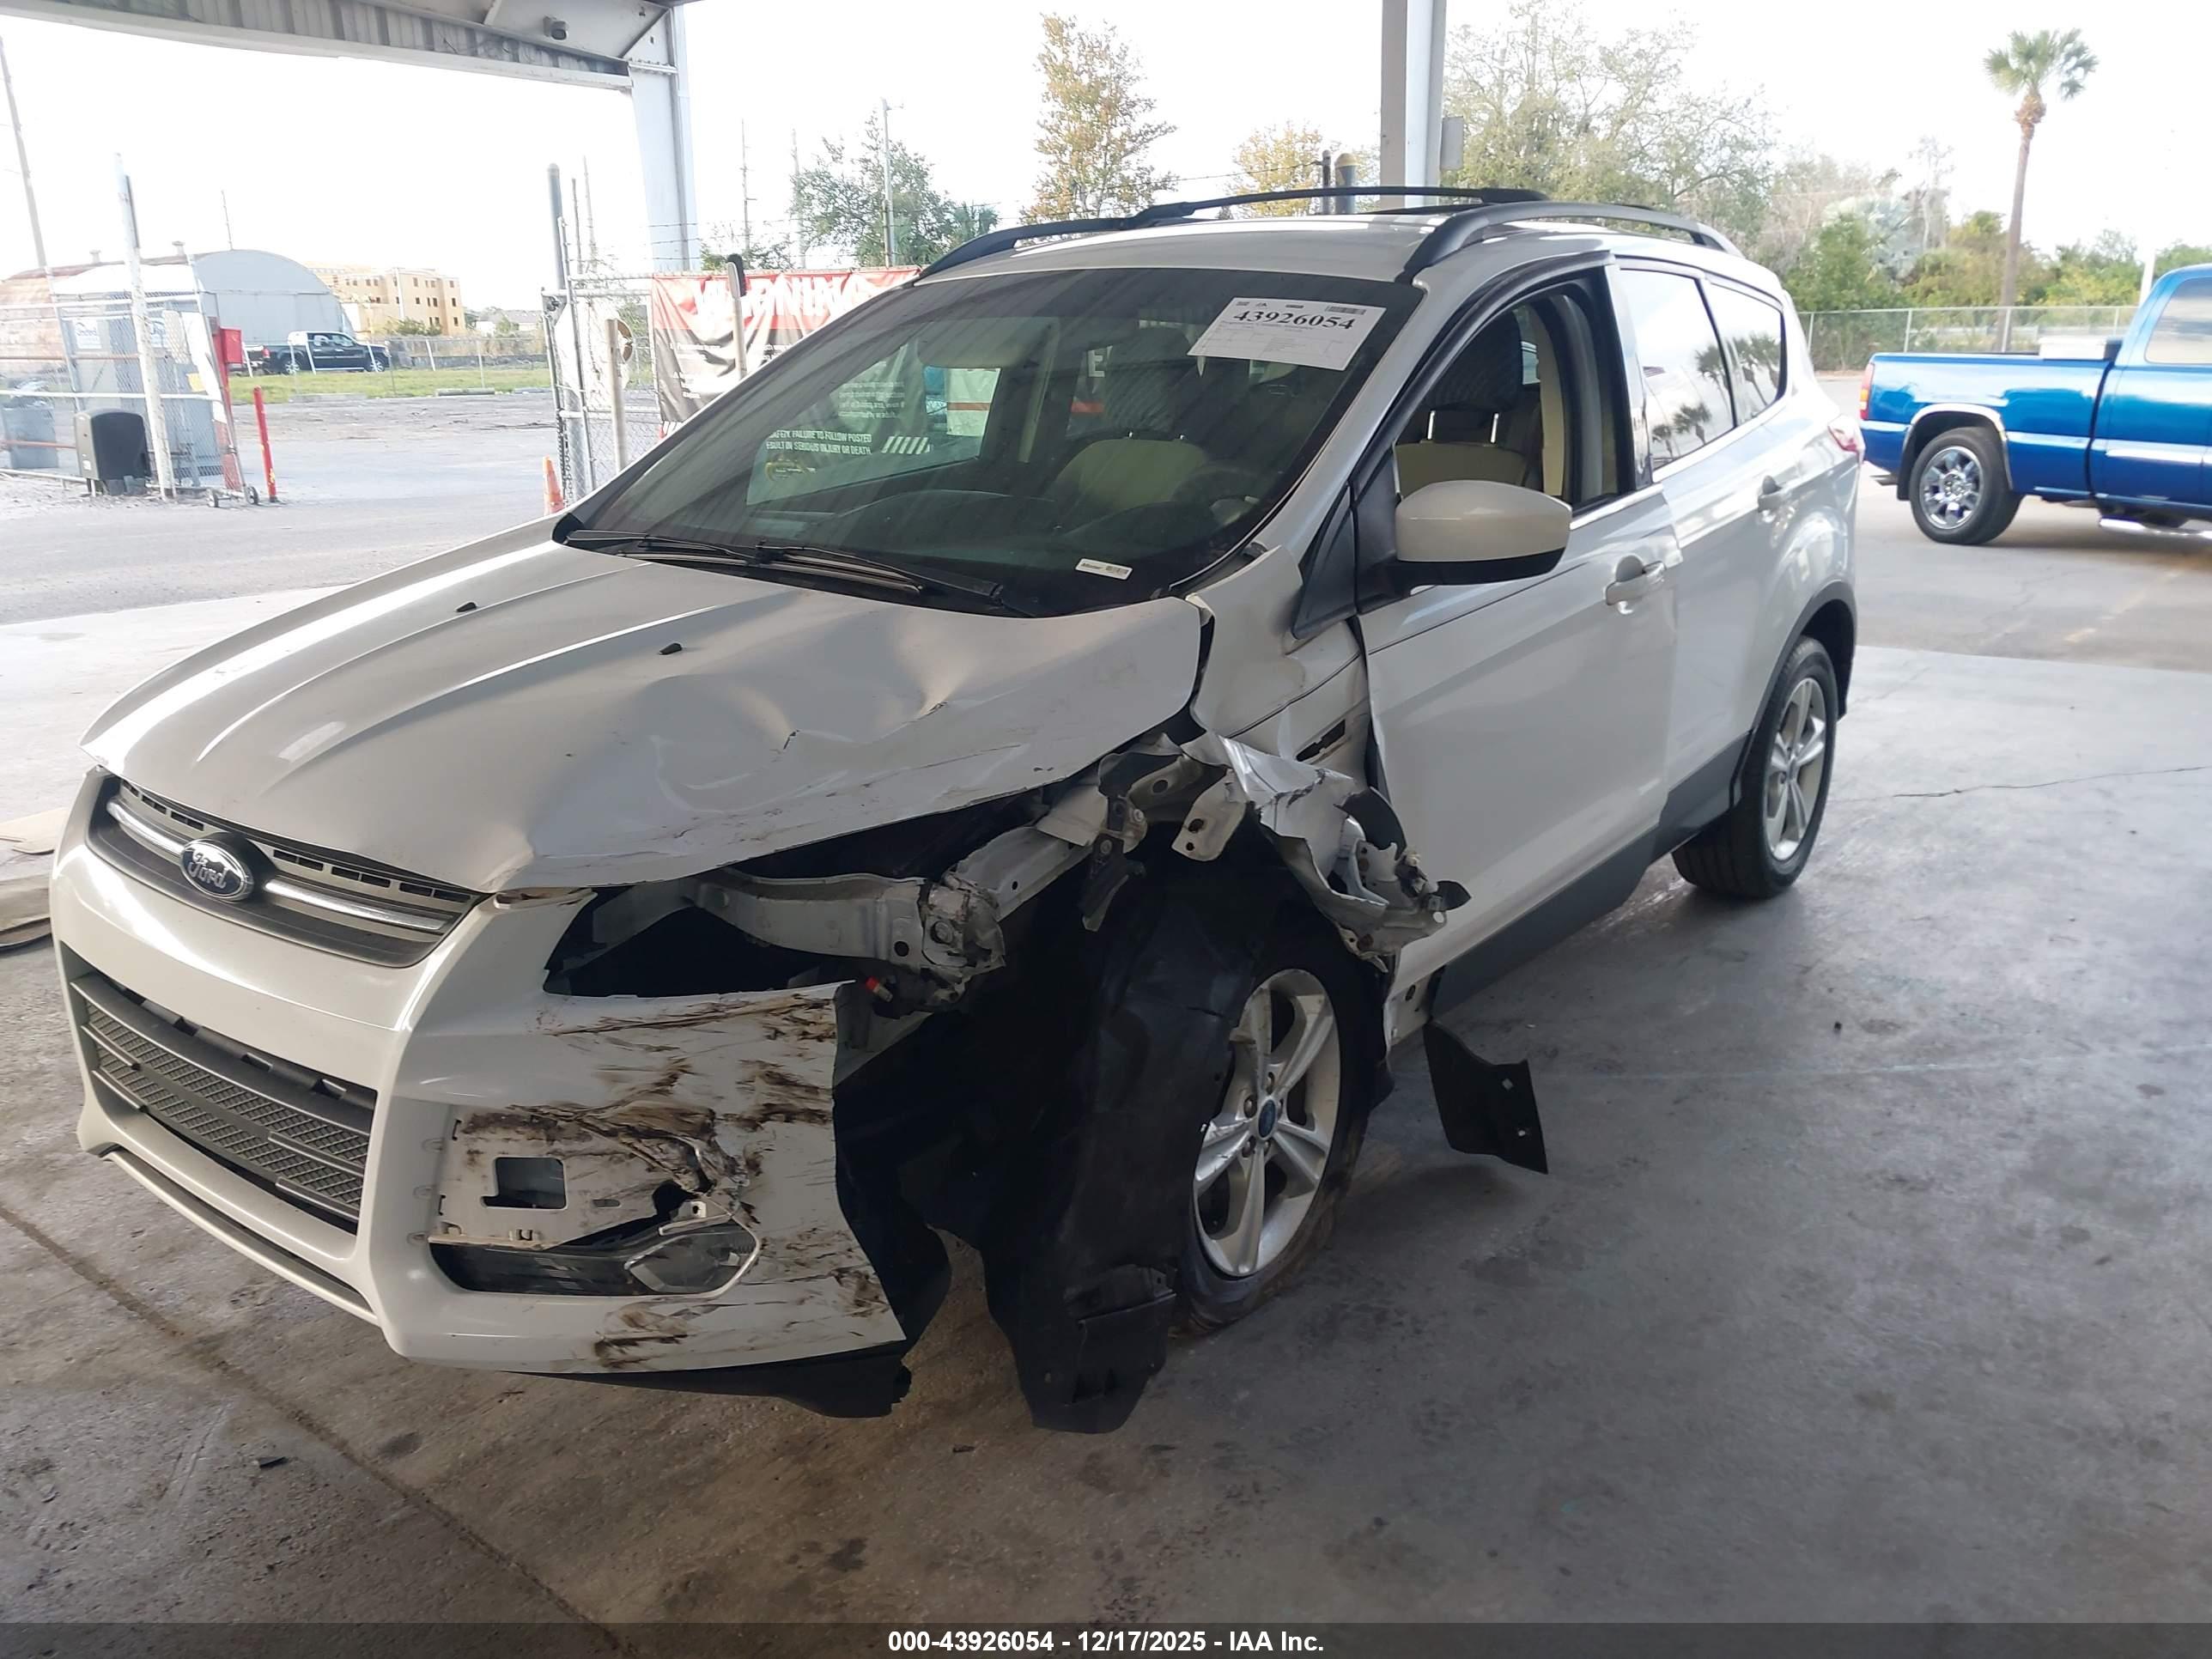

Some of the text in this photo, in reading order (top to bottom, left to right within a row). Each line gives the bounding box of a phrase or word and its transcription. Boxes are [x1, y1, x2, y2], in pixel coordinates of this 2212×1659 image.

[1233, 310, 1356, 330] 43926054
[825, 431, 847, 441] FOLLOW
[848, 433, 872, 443] POSTED
[842, 445, 850, 454] OR
[186, 848, 228, 890] Ford
